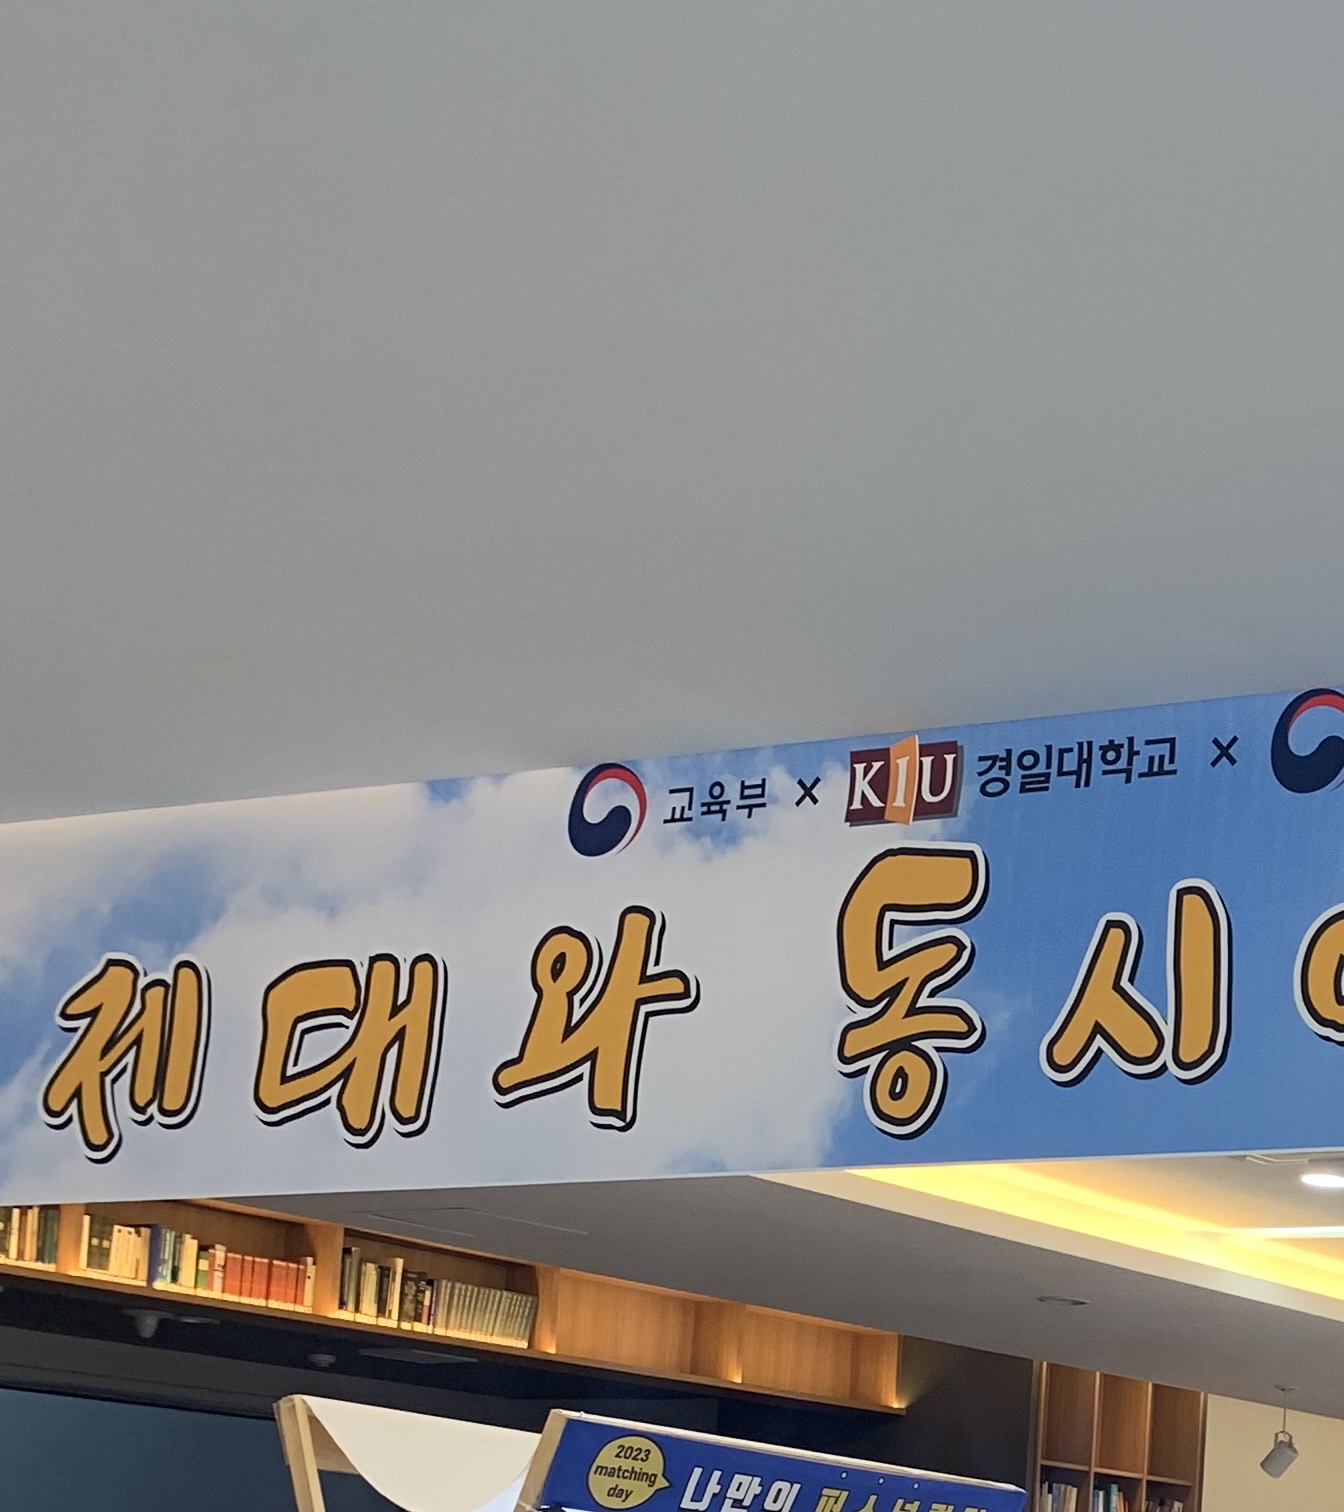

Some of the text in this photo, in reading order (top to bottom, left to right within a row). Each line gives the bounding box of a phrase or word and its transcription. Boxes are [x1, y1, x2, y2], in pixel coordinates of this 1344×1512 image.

[662, 777, 768, 826] 교육부
[847, 750, 959, 813] KIU
[975, 736, 1179, 798] 경일대학교
[42, 903, 701, 1163] 제대와
[614, 1444, 651, 1463] 2023
[593, 1461, 659, 1488] matching
[606, 1484, 634, 1503] day
